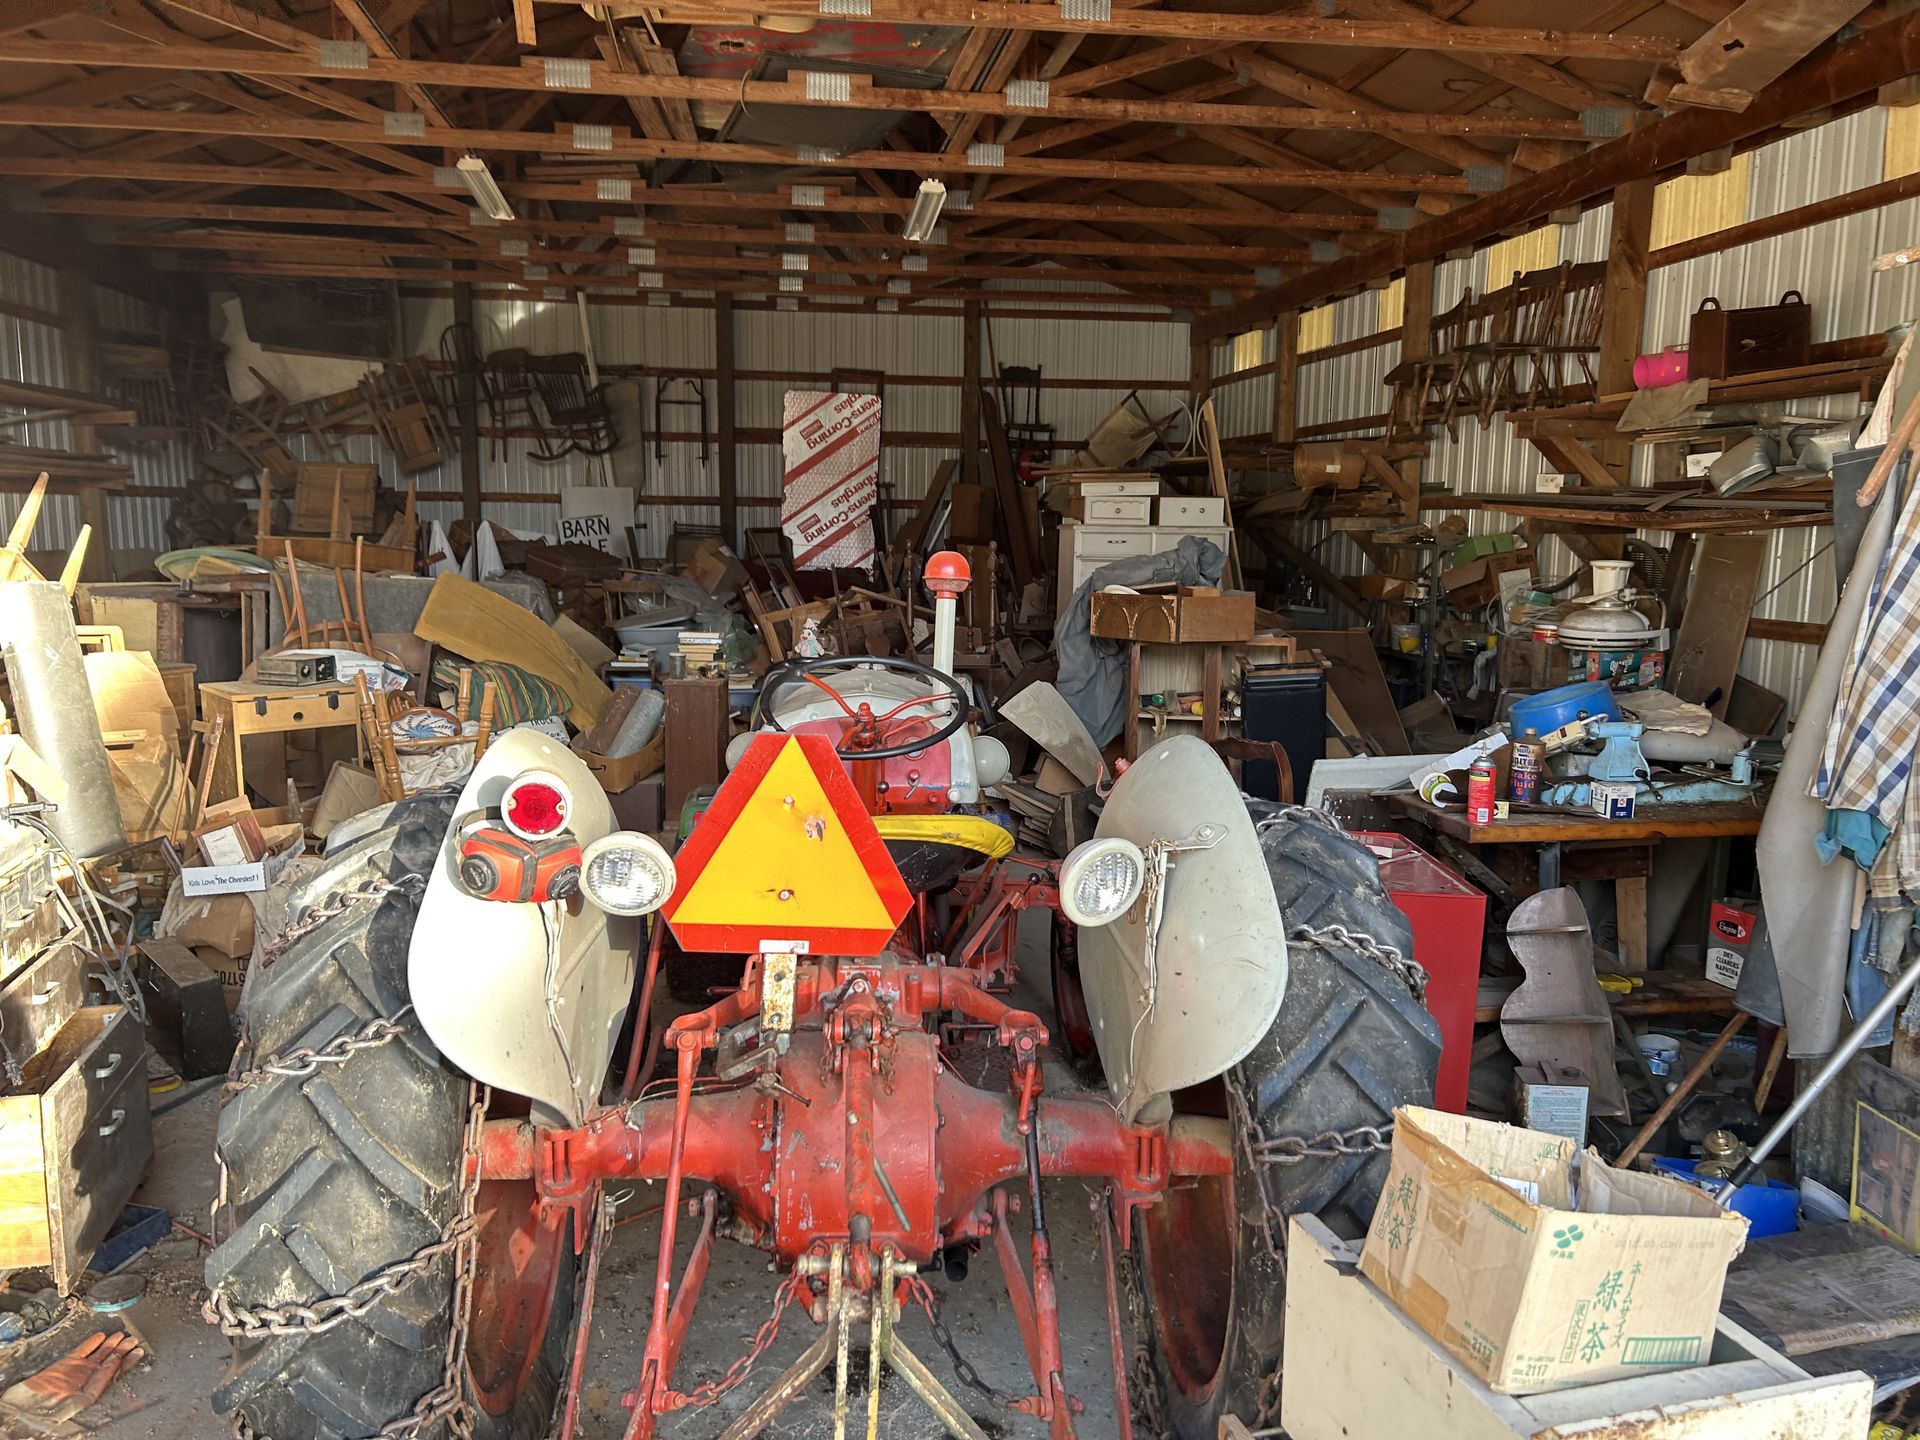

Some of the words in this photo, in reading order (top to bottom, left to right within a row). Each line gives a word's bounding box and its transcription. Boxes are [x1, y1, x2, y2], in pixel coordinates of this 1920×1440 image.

[834, 393, 863, 413] rglas
[806, 394, 881, 449] wens-Corning
[804, 488, 878, 543] wens-Corning
[562, 516, 610, 539] BARN
[188, 879, 201, 888] Kids
[201, 878, 216, 886] Love
[1715, 956, 1740, 970] CLEANERS
[1723, 951, 1733, 960] DRY
[1715, 964, 1738, 977] NAPHTHA
[1579, 1269, 1624, 1363] 緑茶
[1525, 1363, 1549, 1377] 2117
